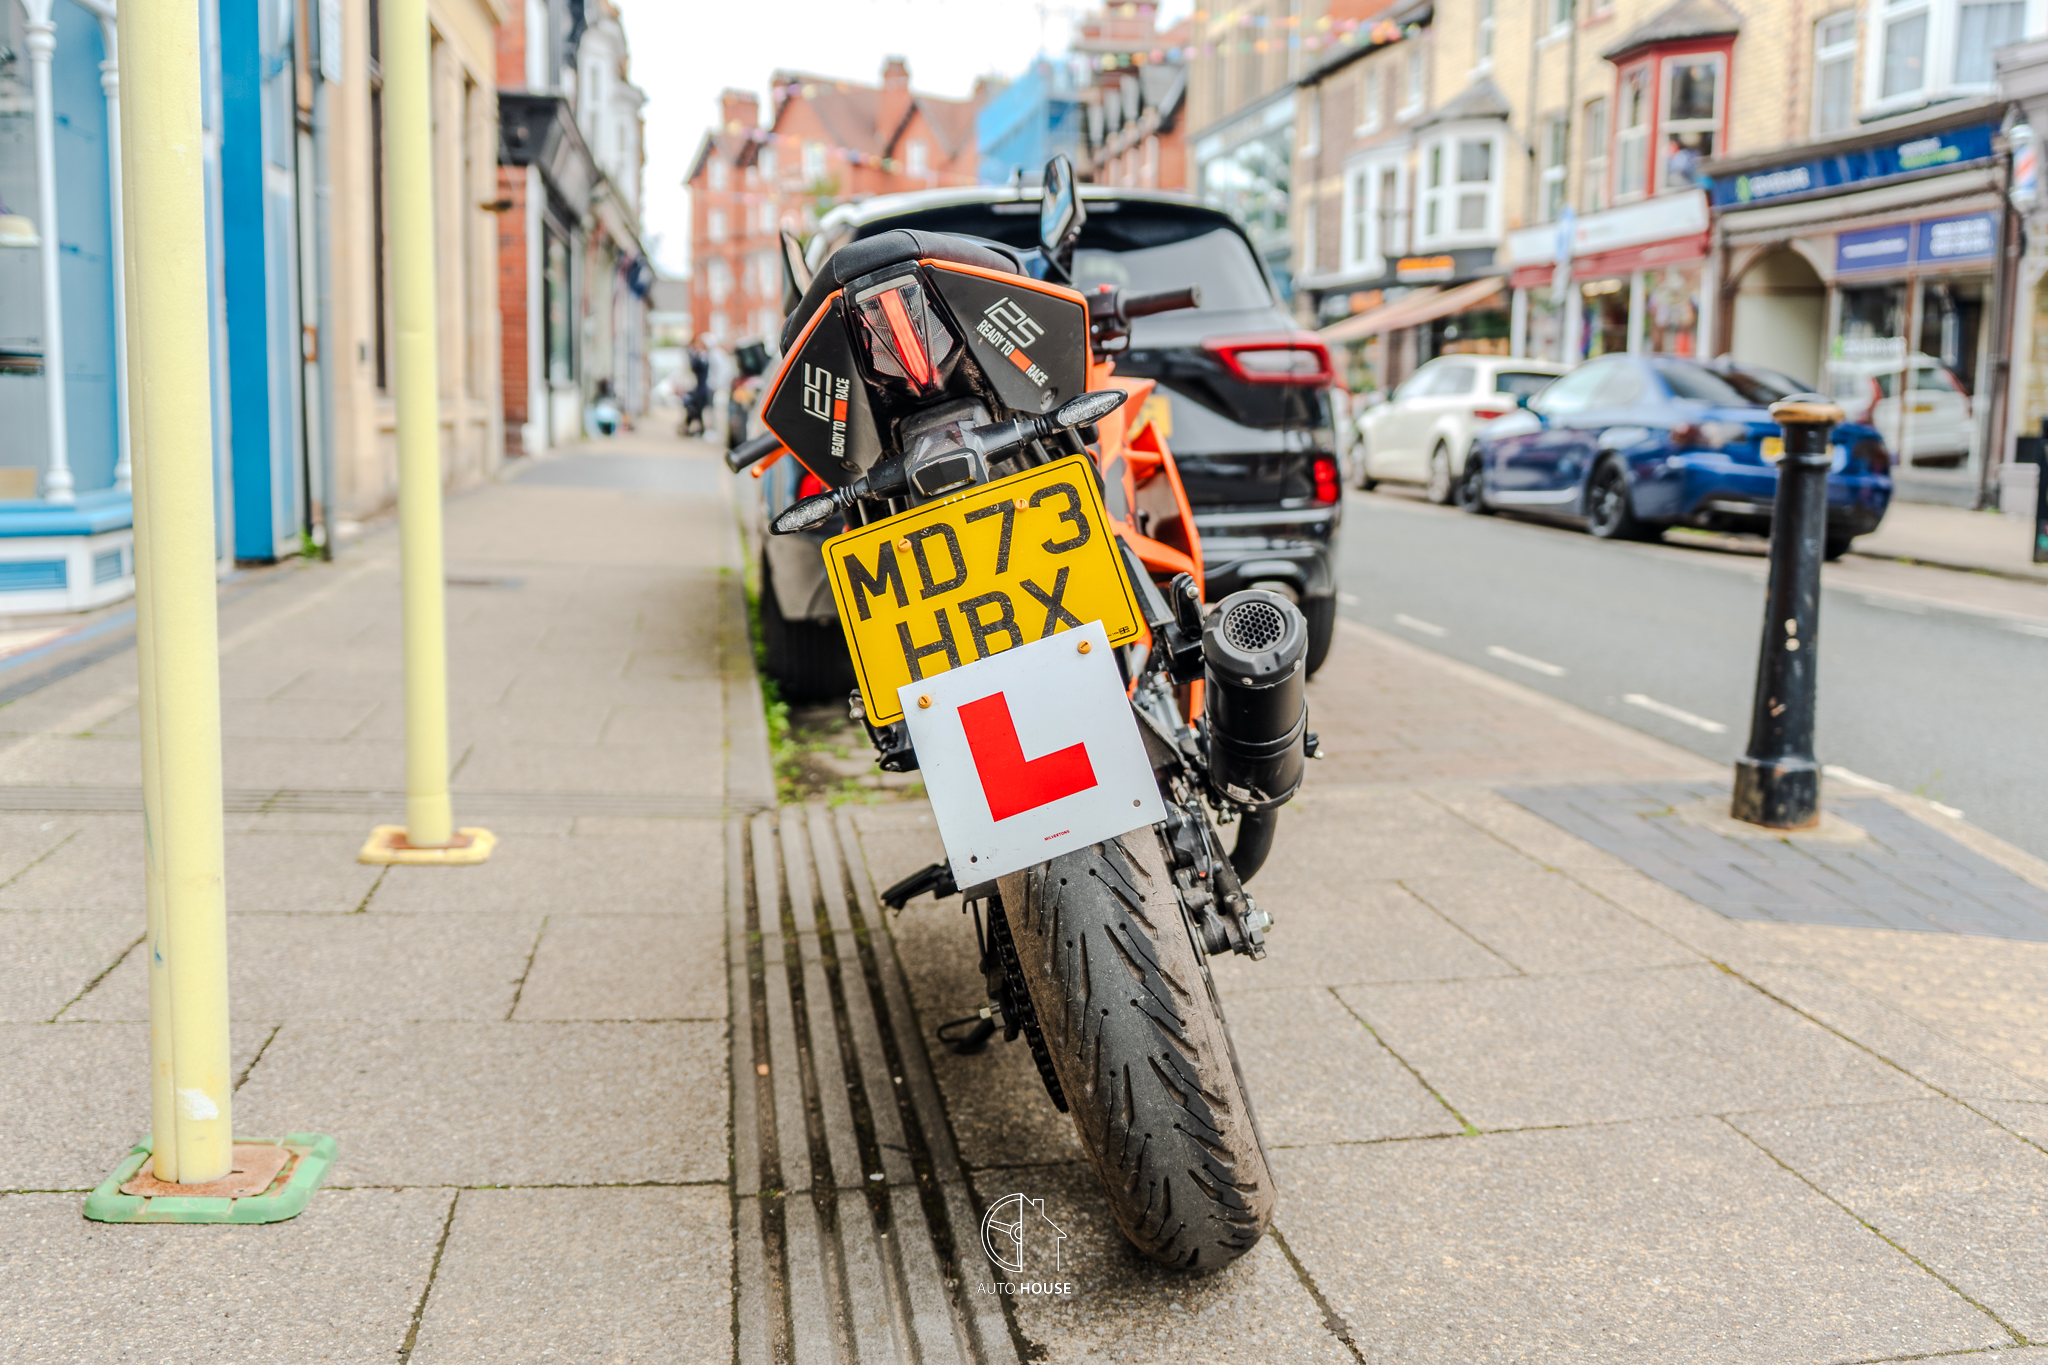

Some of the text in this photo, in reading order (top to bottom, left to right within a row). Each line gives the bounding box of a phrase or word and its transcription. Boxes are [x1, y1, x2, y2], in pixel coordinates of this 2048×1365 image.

[976, 319, 1049, 387] READY TO RACE
[984, 297, 1045, 348] 125
[804, 363, 832, 422] 125
[831, 377, 850, 457] READY TO RACE
[843, 482, 1091, 621] MD73
[896, 566, 1085, 683] HBX
[957, 691, 1098, 822] L
